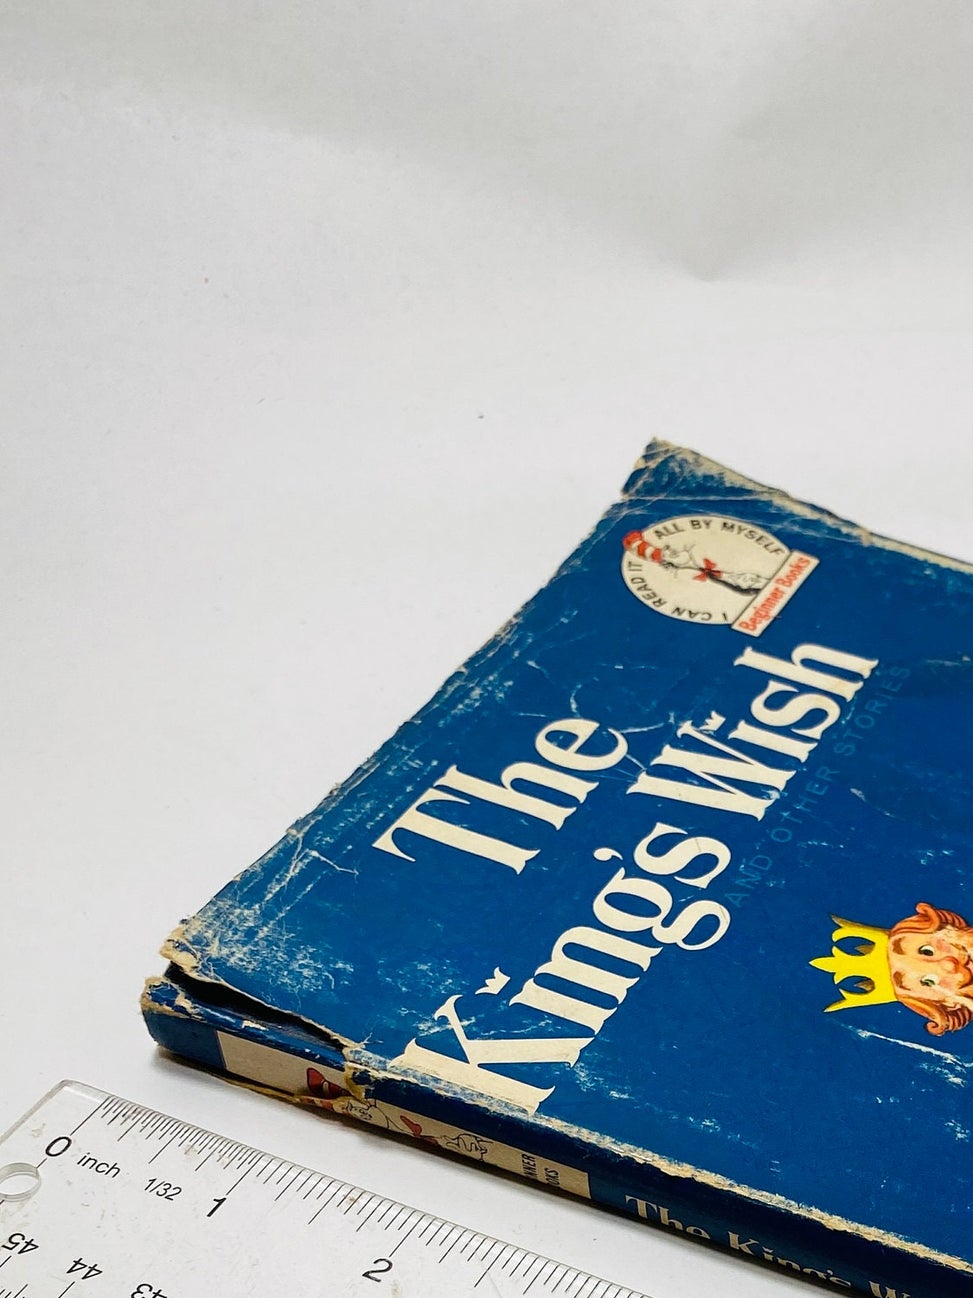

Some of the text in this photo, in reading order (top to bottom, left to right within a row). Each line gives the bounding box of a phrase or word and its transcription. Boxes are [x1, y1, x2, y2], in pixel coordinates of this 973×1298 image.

[628, 518, 786, 622] I CAN READ IT ALL BY MYSELF
[738, 556, 812, 632] Beginner Books
[371, 717, 629, 875] The
[724, 666, 911, 909] AND OTHER STORIES
[387, 642, 879, 1117] King's Wish
[44, 1134, 184, 1202] 0 inch 1/32
[205, 1196, 228, 1218] 1
[1, 1231, 41, 1256] 45
[65, 1256, 104, 1281] 44
[361, 1256, 394, 1284] 2
